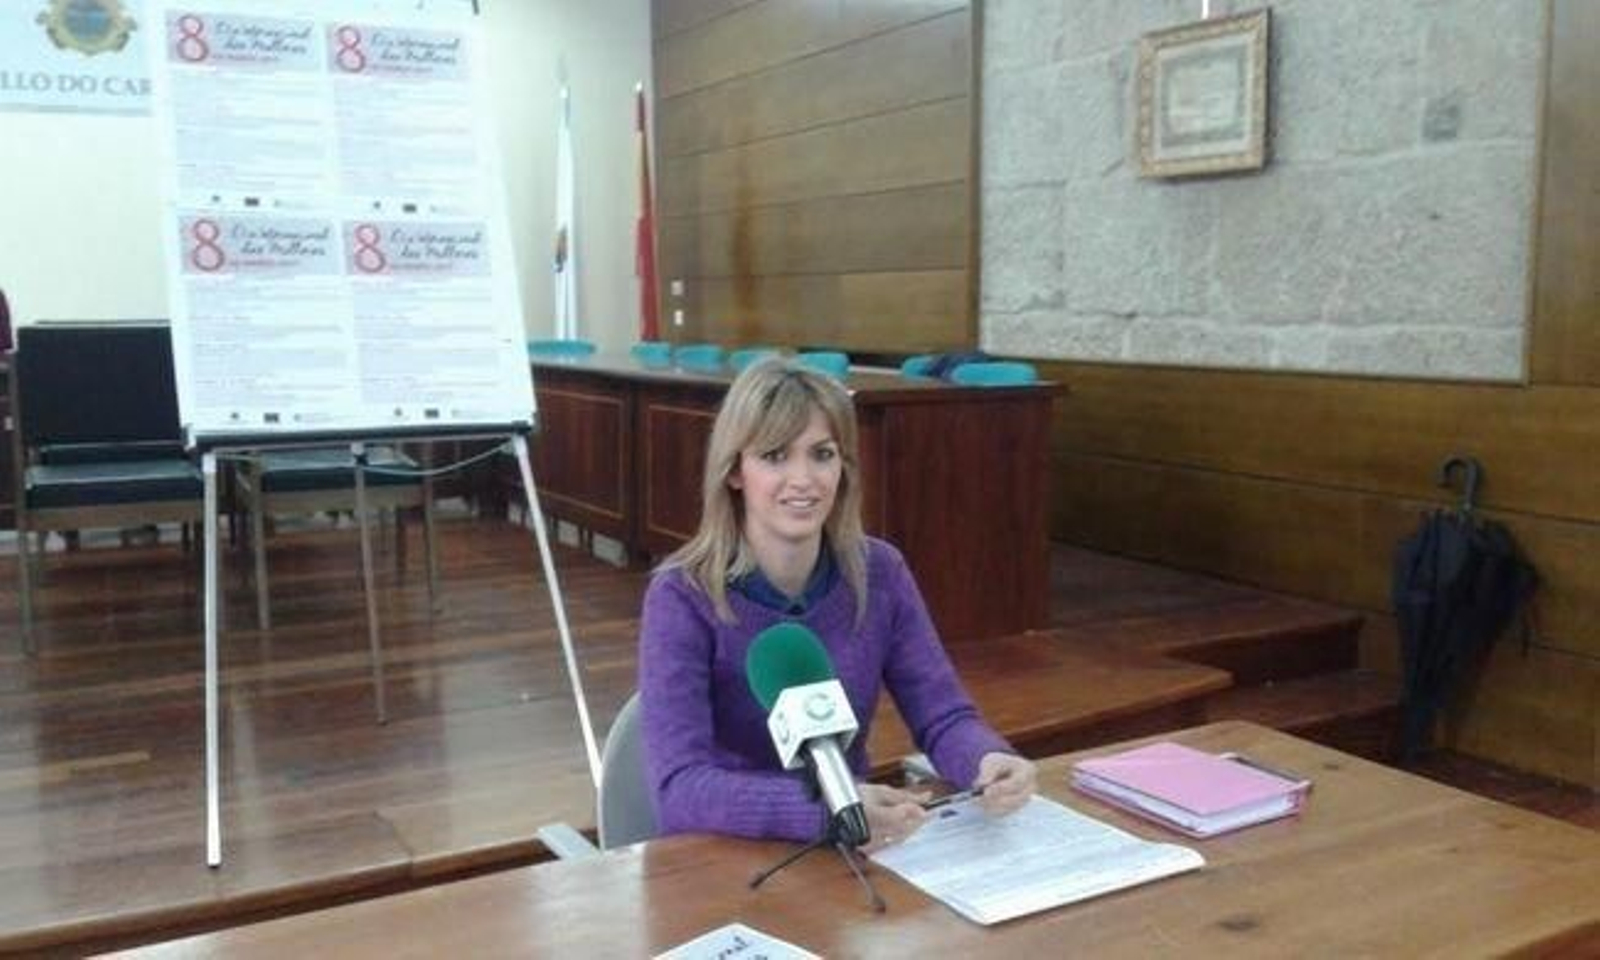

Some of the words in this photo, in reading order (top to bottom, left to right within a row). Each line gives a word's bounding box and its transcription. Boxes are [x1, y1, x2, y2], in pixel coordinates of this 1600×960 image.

[176, 14, 209, 62] 8
[335, 25, 366, 73] 8
[58, 75, 98, 93] DO
[192, 218, 225, 272] 8
[355, 224, 387, 273] 8
